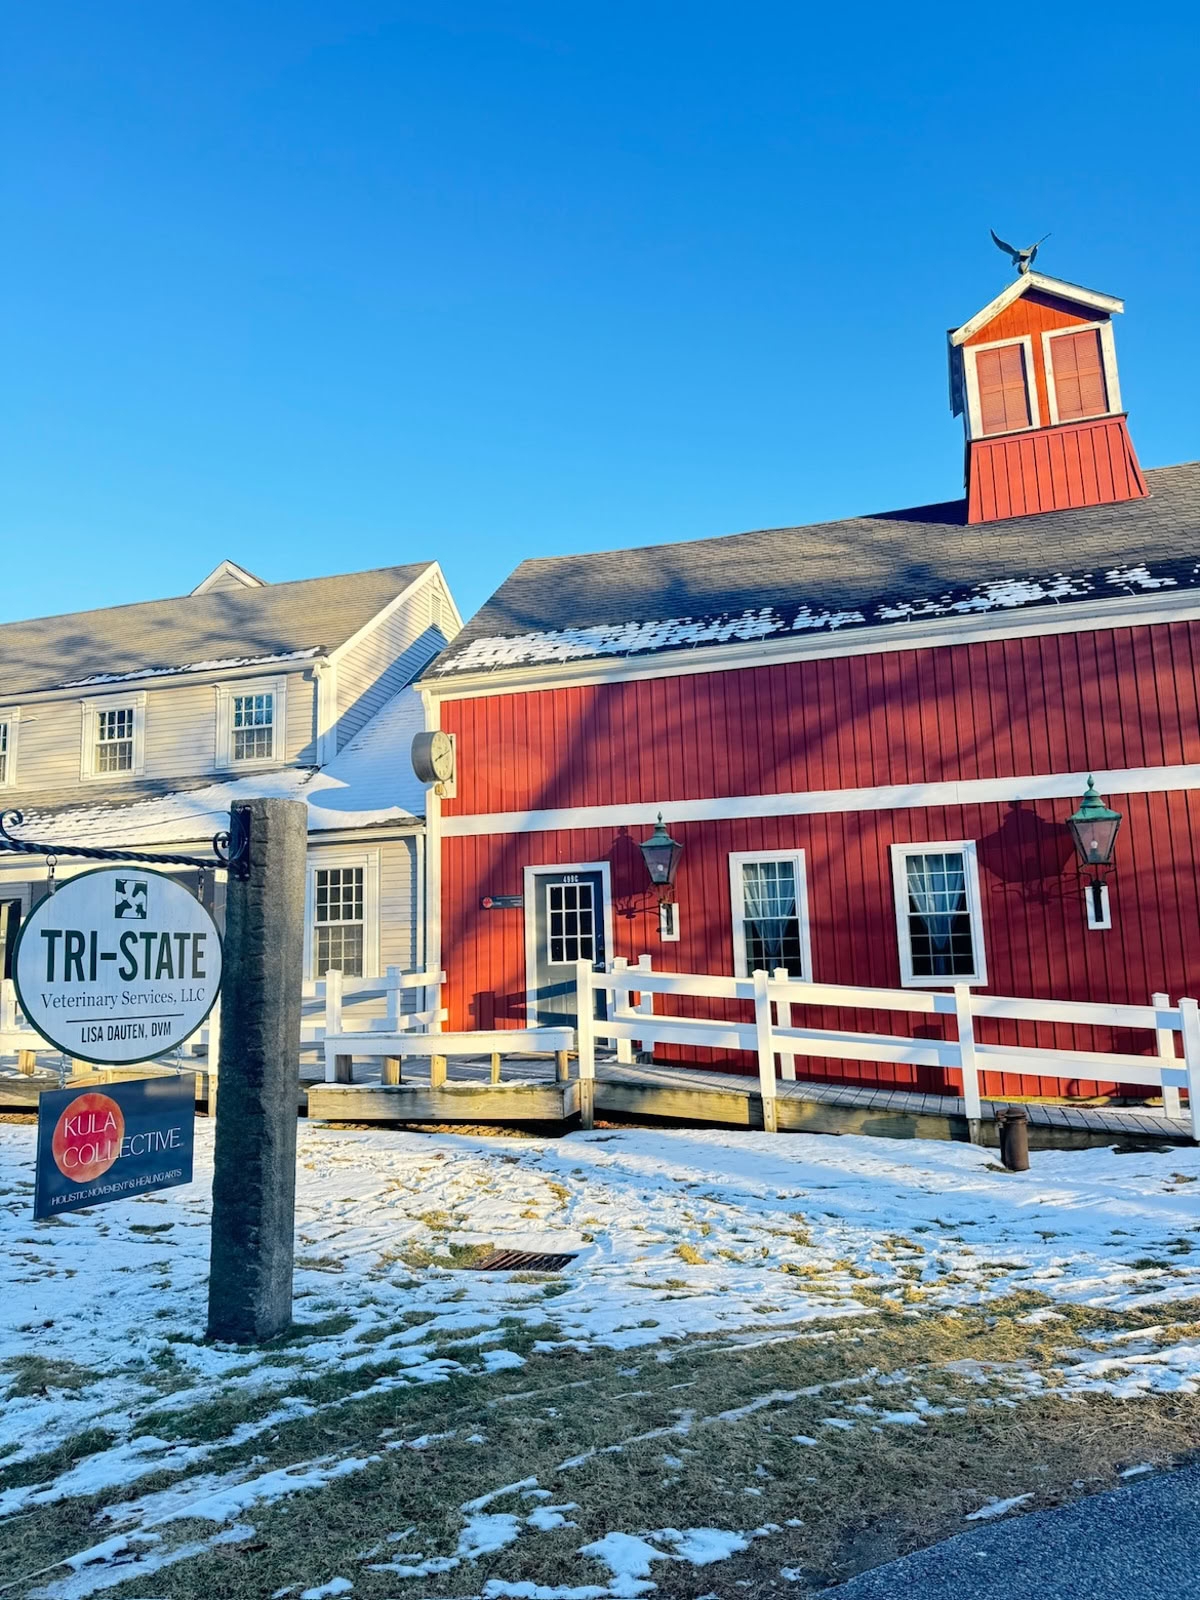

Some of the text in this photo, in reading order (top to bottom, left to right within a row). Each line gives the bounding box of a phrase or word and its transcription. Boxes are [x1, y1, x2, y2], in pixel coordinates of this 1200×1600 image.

[41, 929, 207, 982] TRI-STATE
[41, 988, 205, 1010] Veterinary Services, LLC
[81, 1021, 171, 1043] LISA DAUTEN, DVM
[64, 1111, 117, 1138] KULA
[62, 1127, 181, 1168] COLLECTIVE
[51, 1168, 182, 1206] HOLISTIC MOVEMENT & HEALING ARTS
